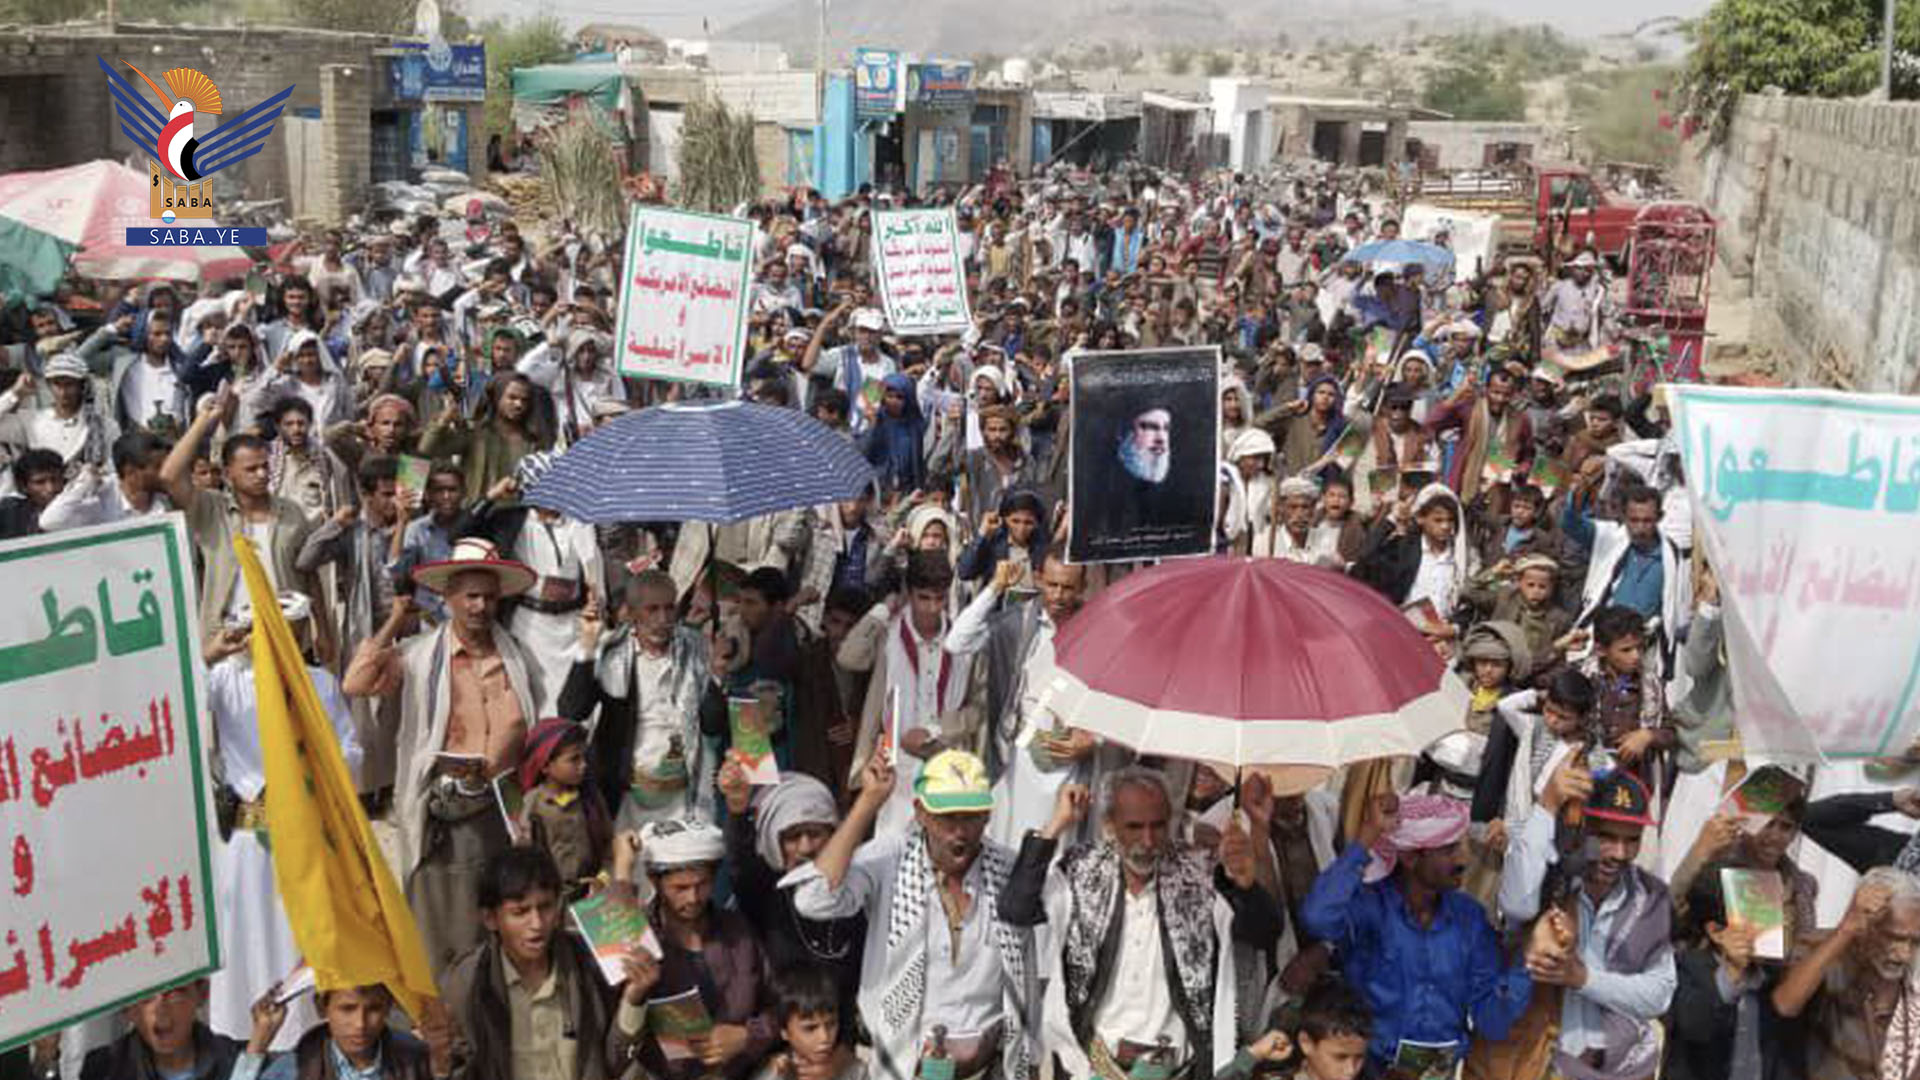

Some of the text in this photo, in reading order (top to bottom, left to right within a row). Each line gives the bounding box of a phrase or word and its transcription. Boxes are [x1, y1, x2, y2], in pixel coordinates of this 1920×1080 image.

[640, 220, 744, 262] قاطعوا
[31, 692, 175, 809] البضائع
[13, 834, 33, 897] و
